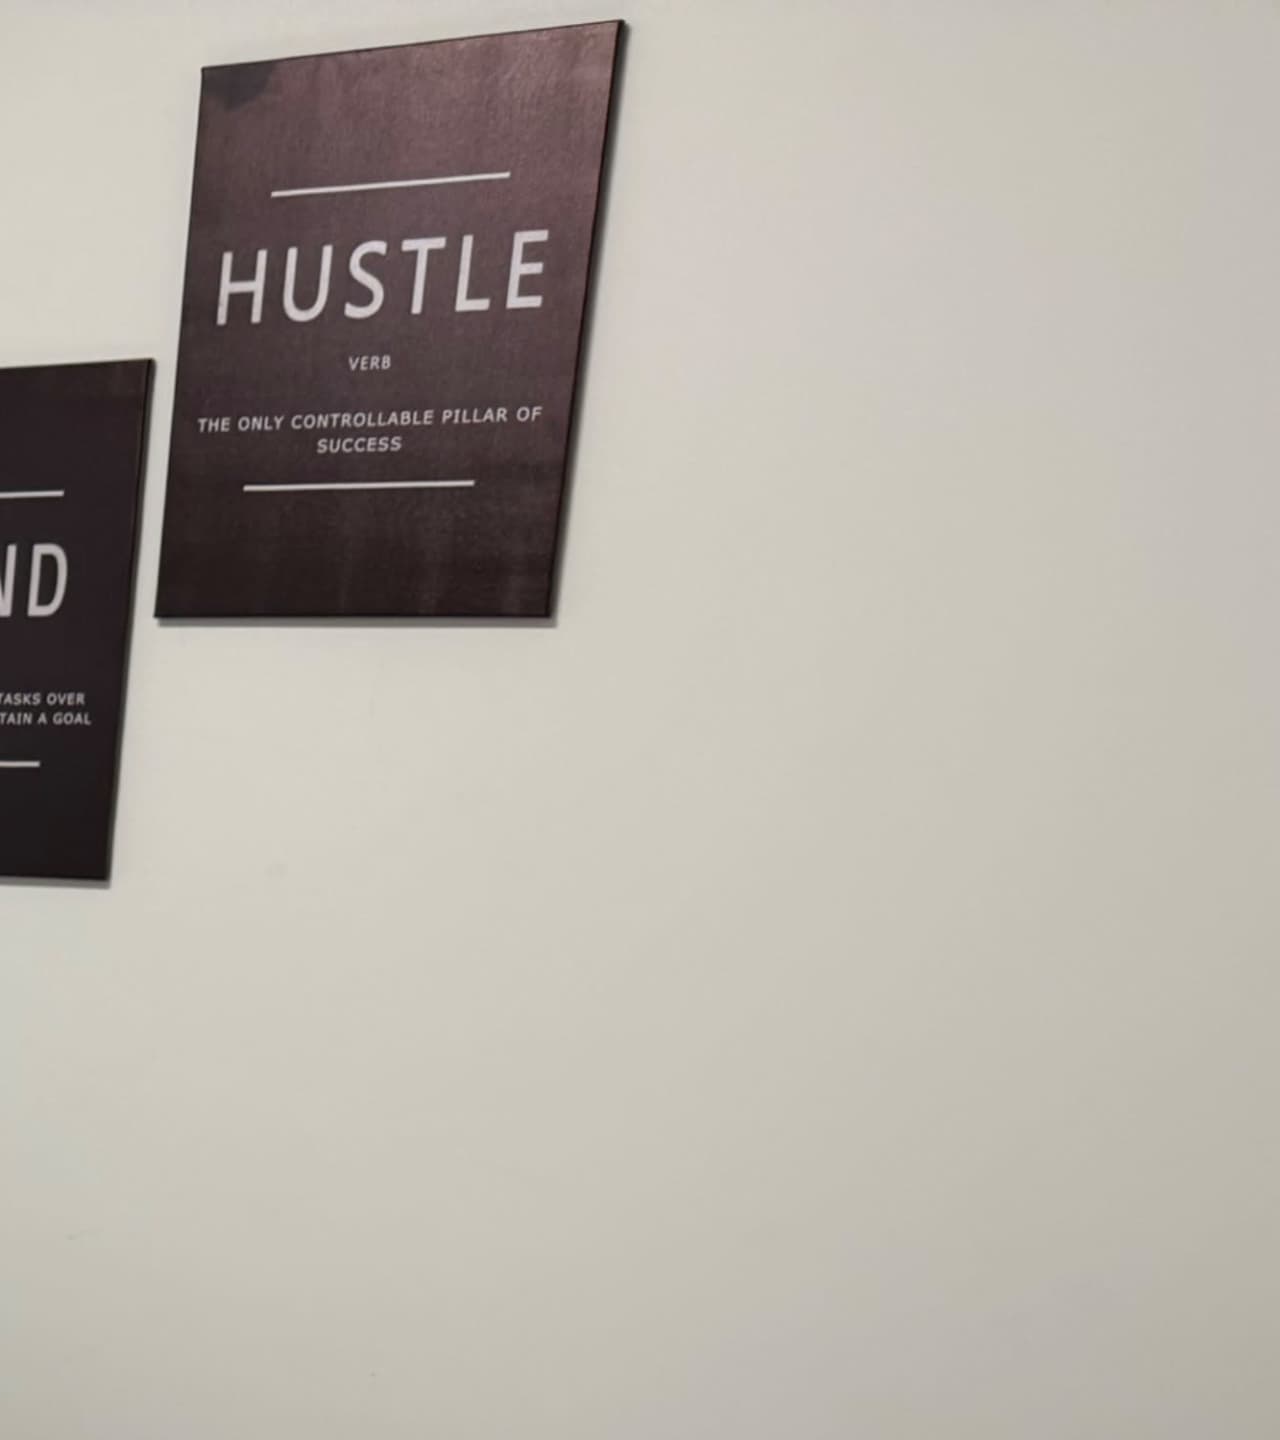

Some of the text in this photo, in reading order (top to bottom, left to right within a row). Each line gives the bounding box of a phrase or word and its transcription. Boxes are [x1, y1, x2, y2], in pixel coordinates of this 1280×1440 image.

[216, 229, 549, 326] HUSTLE
[348, 355, 392, 371] VERB
[197, 406, 543, 433] THE ONLY CONTROLLABLE PILLAR OF
[316, 436, 403, 454] SUCCESS
[46, 693, 85, 706] OVER
[38, 712, 48, 725] A
[53, 712, 92, 726] GOAL
